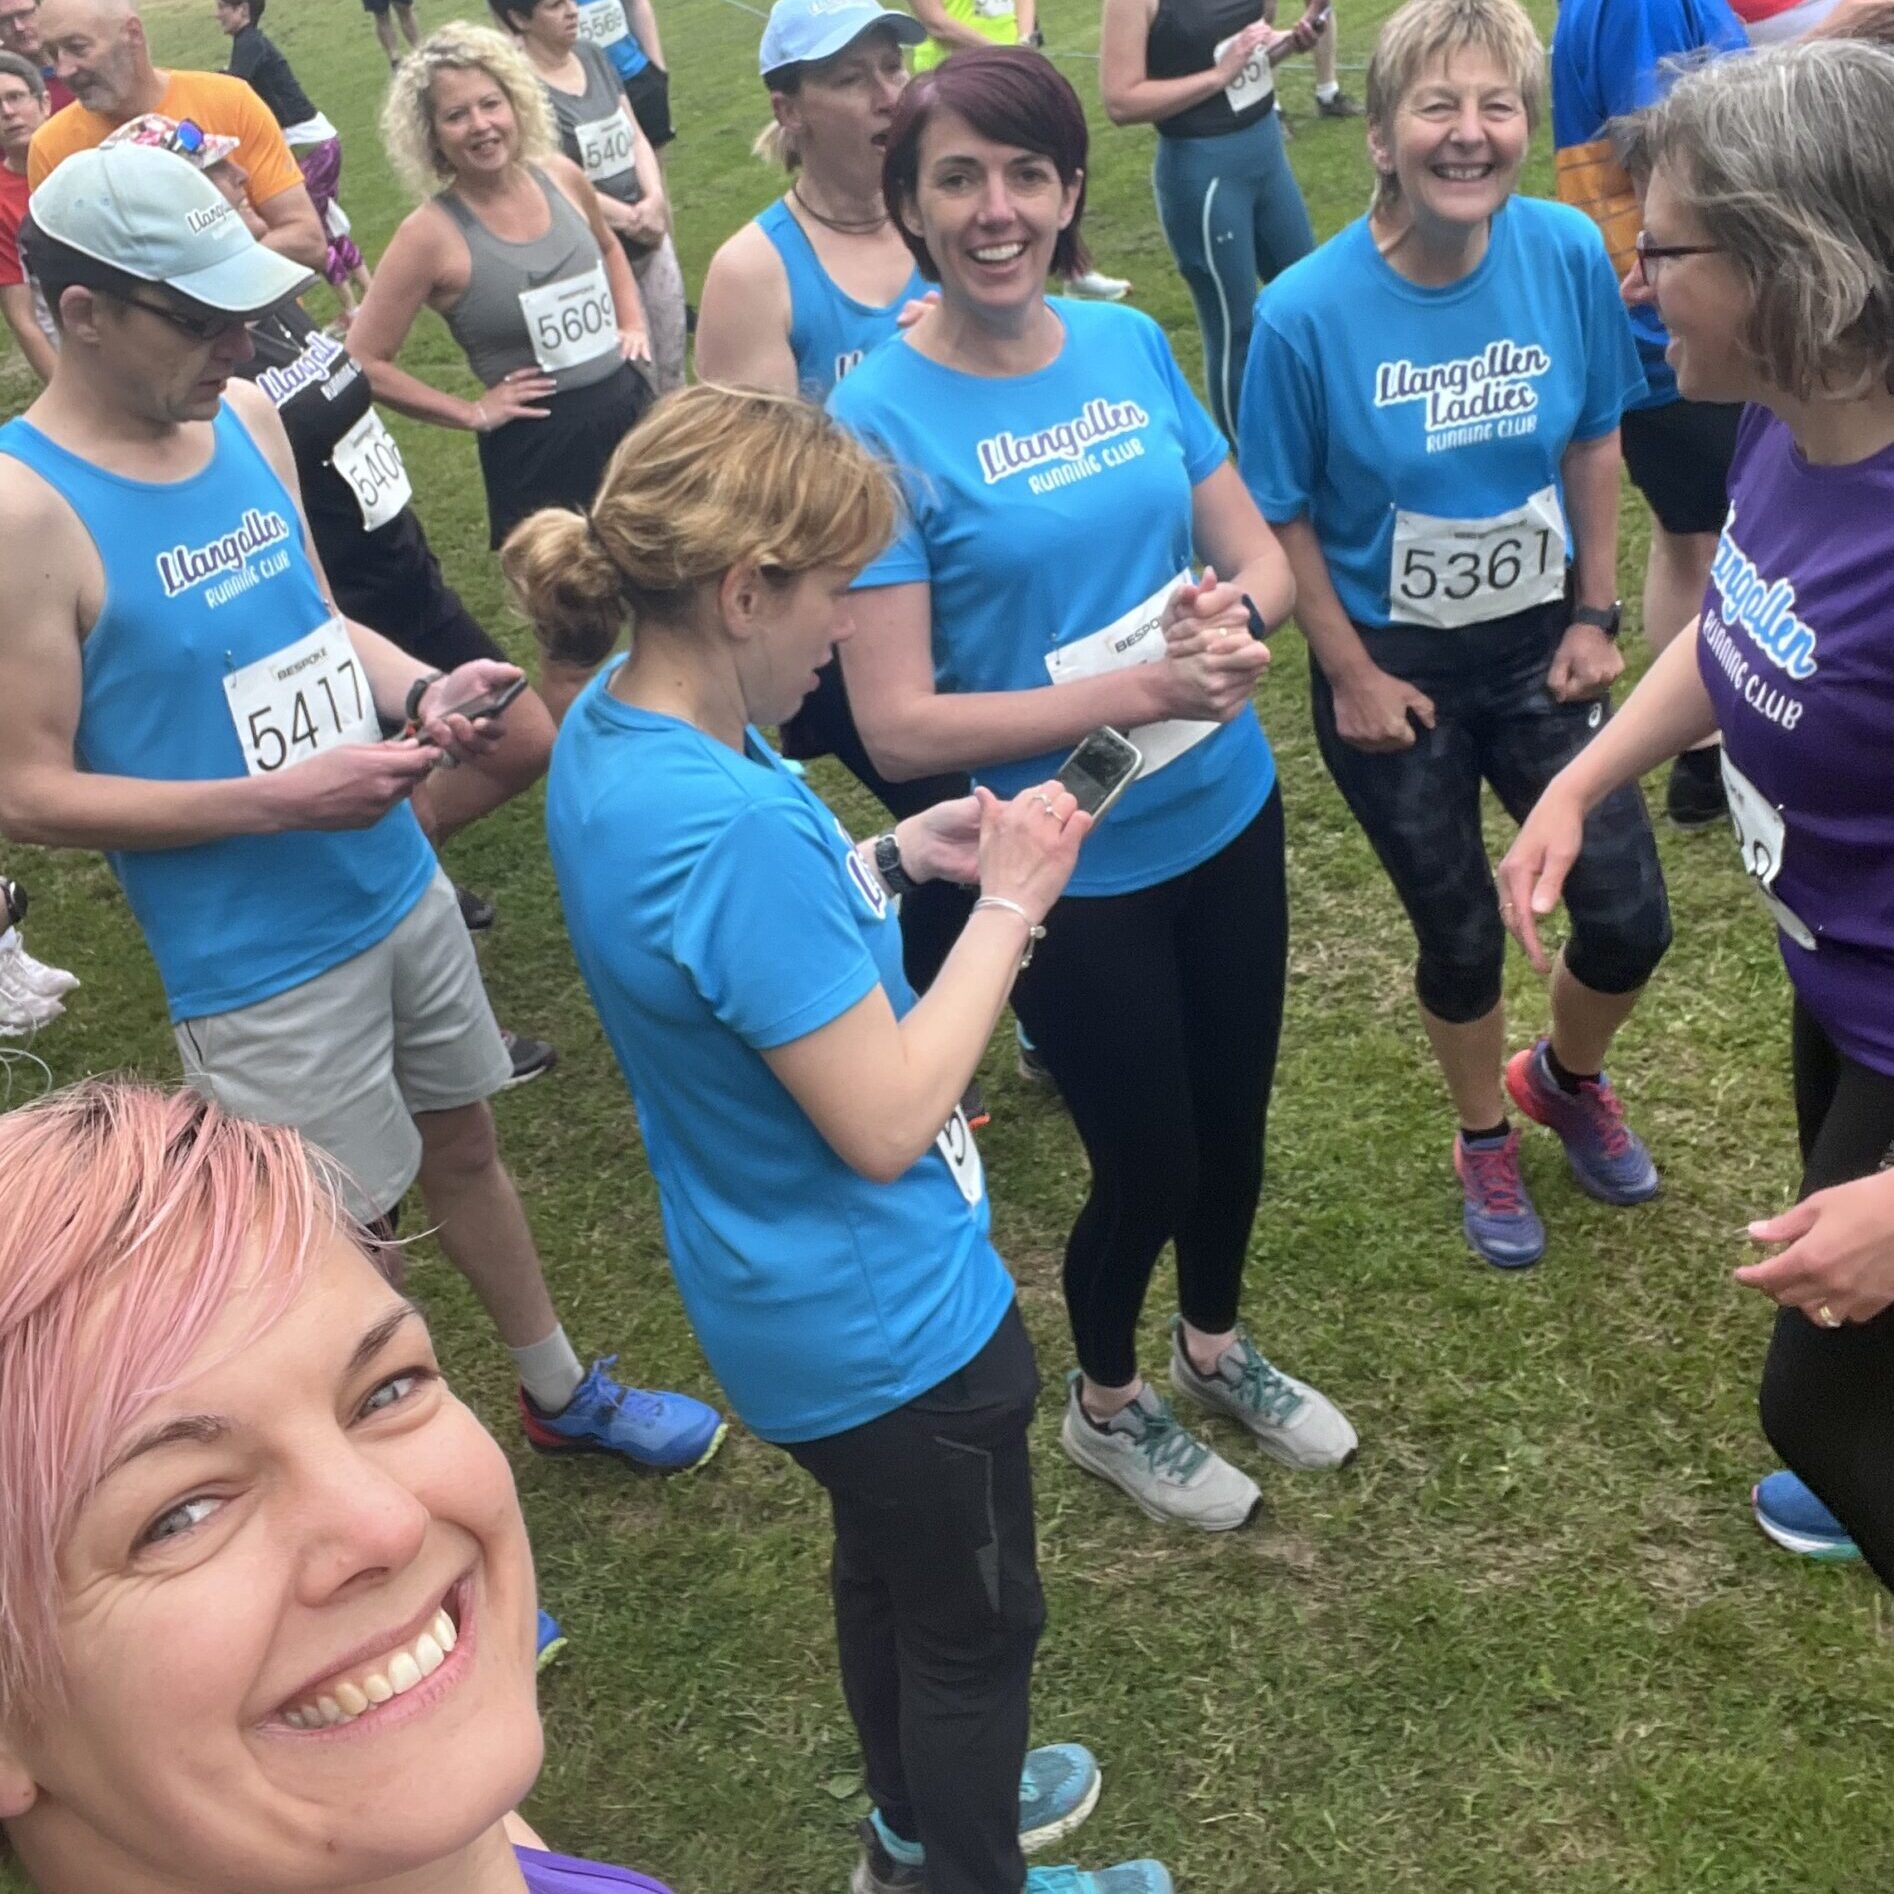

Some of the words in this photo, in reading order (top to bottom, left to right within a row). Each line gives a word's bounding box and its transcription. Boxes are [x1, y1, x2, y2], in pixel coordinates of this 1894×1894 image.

[1374, 339, 1551, 407] Llangollen
[1425, 381, 1539, 431] Ladies
[1426, 422, 1492, 454] RUNNING
[1497, 415, 1538, 439] CLUB
[977, 398, 1149, 484] Llangollen
[1028, 454, 1102, 495] RUNNING
[1102, 438, 1145, 467] CLUB
[156, 508, 290, 597] Llangollen
[205, 565, 260, 609] RUNNING
[260, 549, 291, 578] CLUB
[1401, 530, 1548, 599] 5361
[277, 648, 328, 680] BESPOKE
[1115, 617, 1160, 654] BESPO
[248, 658, 363, 771] 5417
[1745, 675, 1803, 730] CLUB
